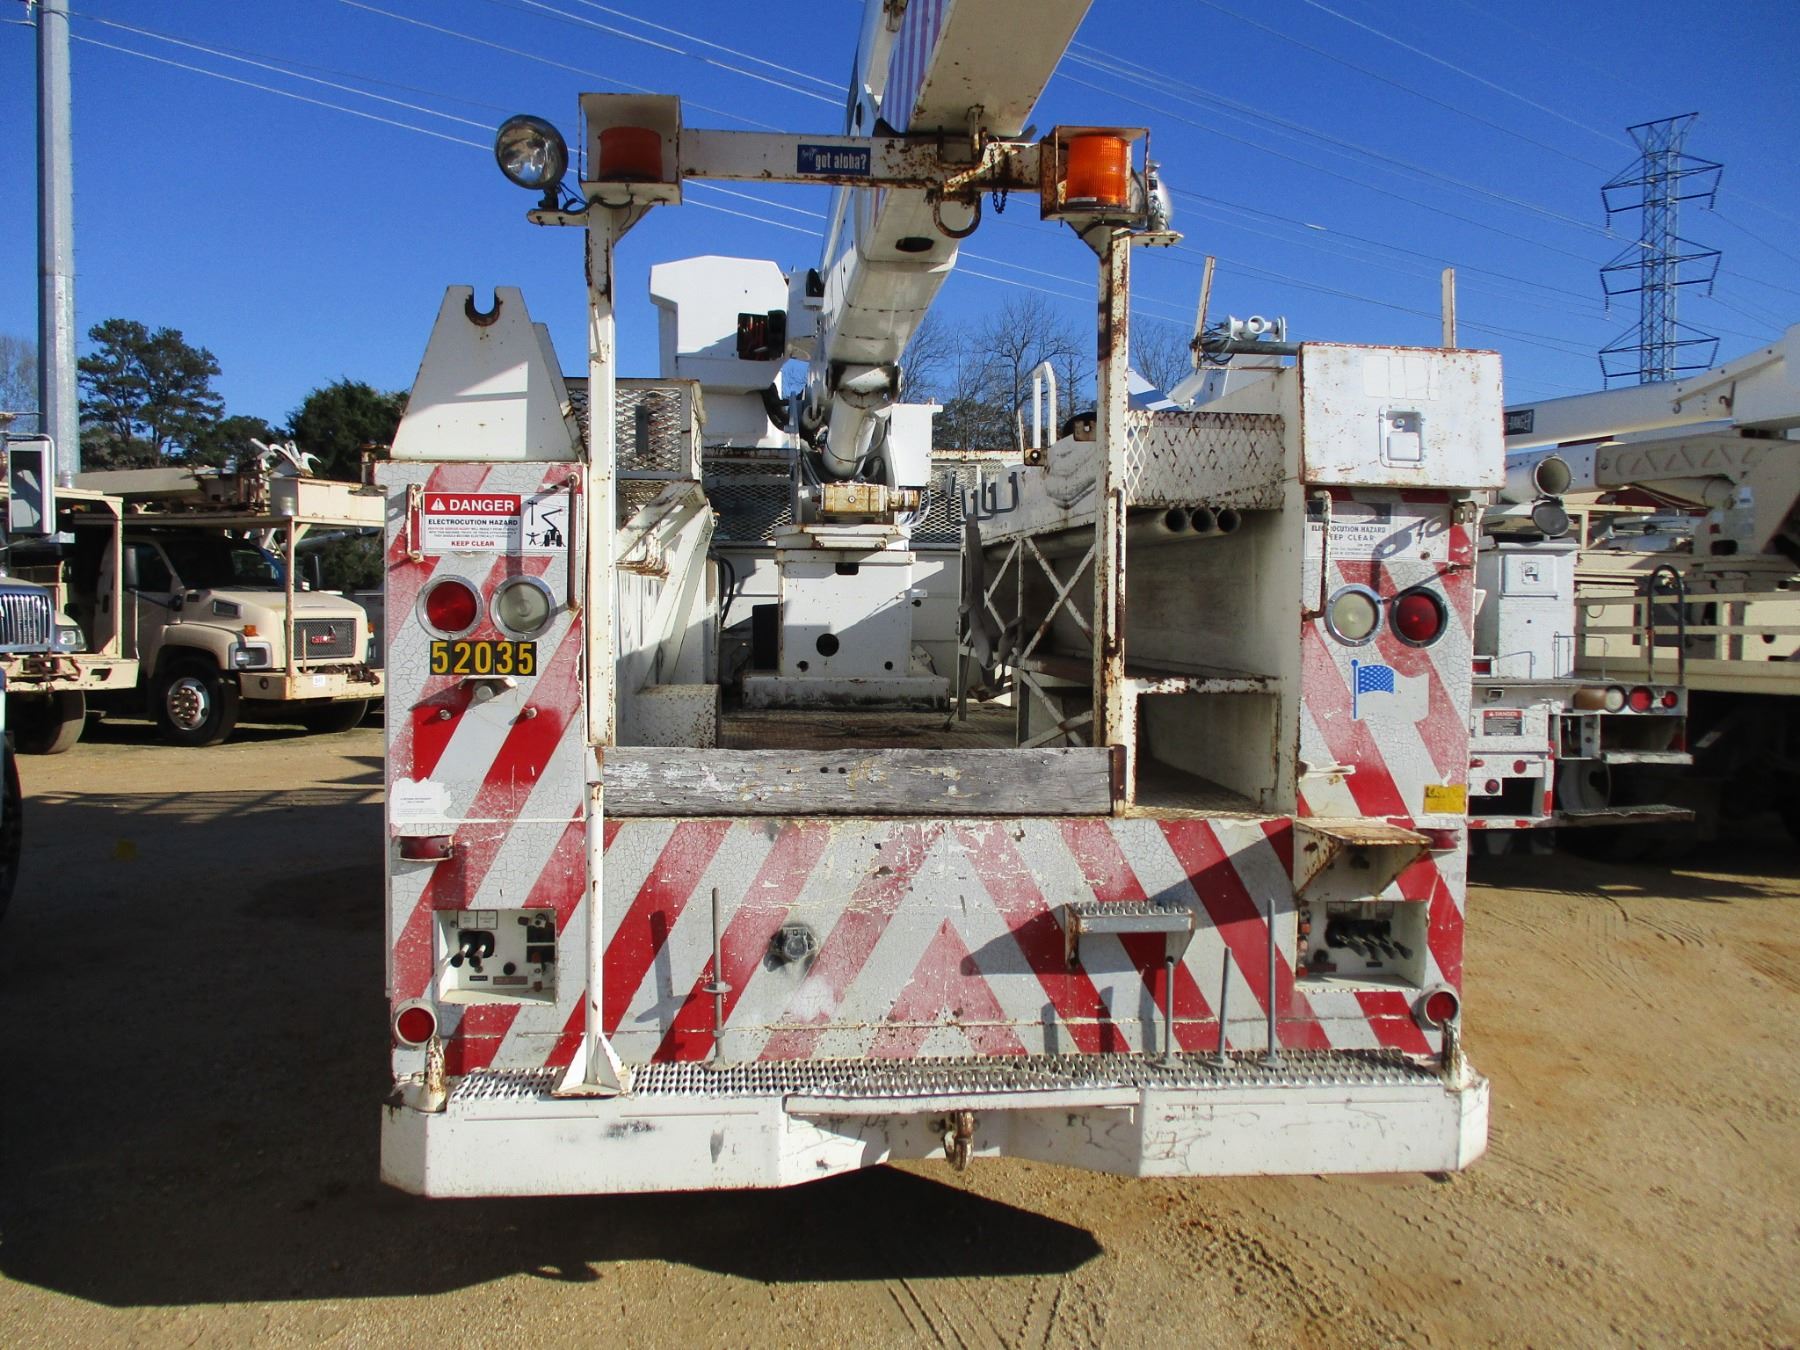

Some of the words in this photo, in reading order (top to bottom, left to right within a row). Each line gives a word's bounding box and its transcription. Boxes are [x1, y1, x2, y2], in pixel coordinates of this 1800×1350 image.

[815, 152, 831, 171] got
[833, 152, 867, 170] aloha?
[449, 499, 514, 512] DANGER
[432, 641, 533, 674] 52035
